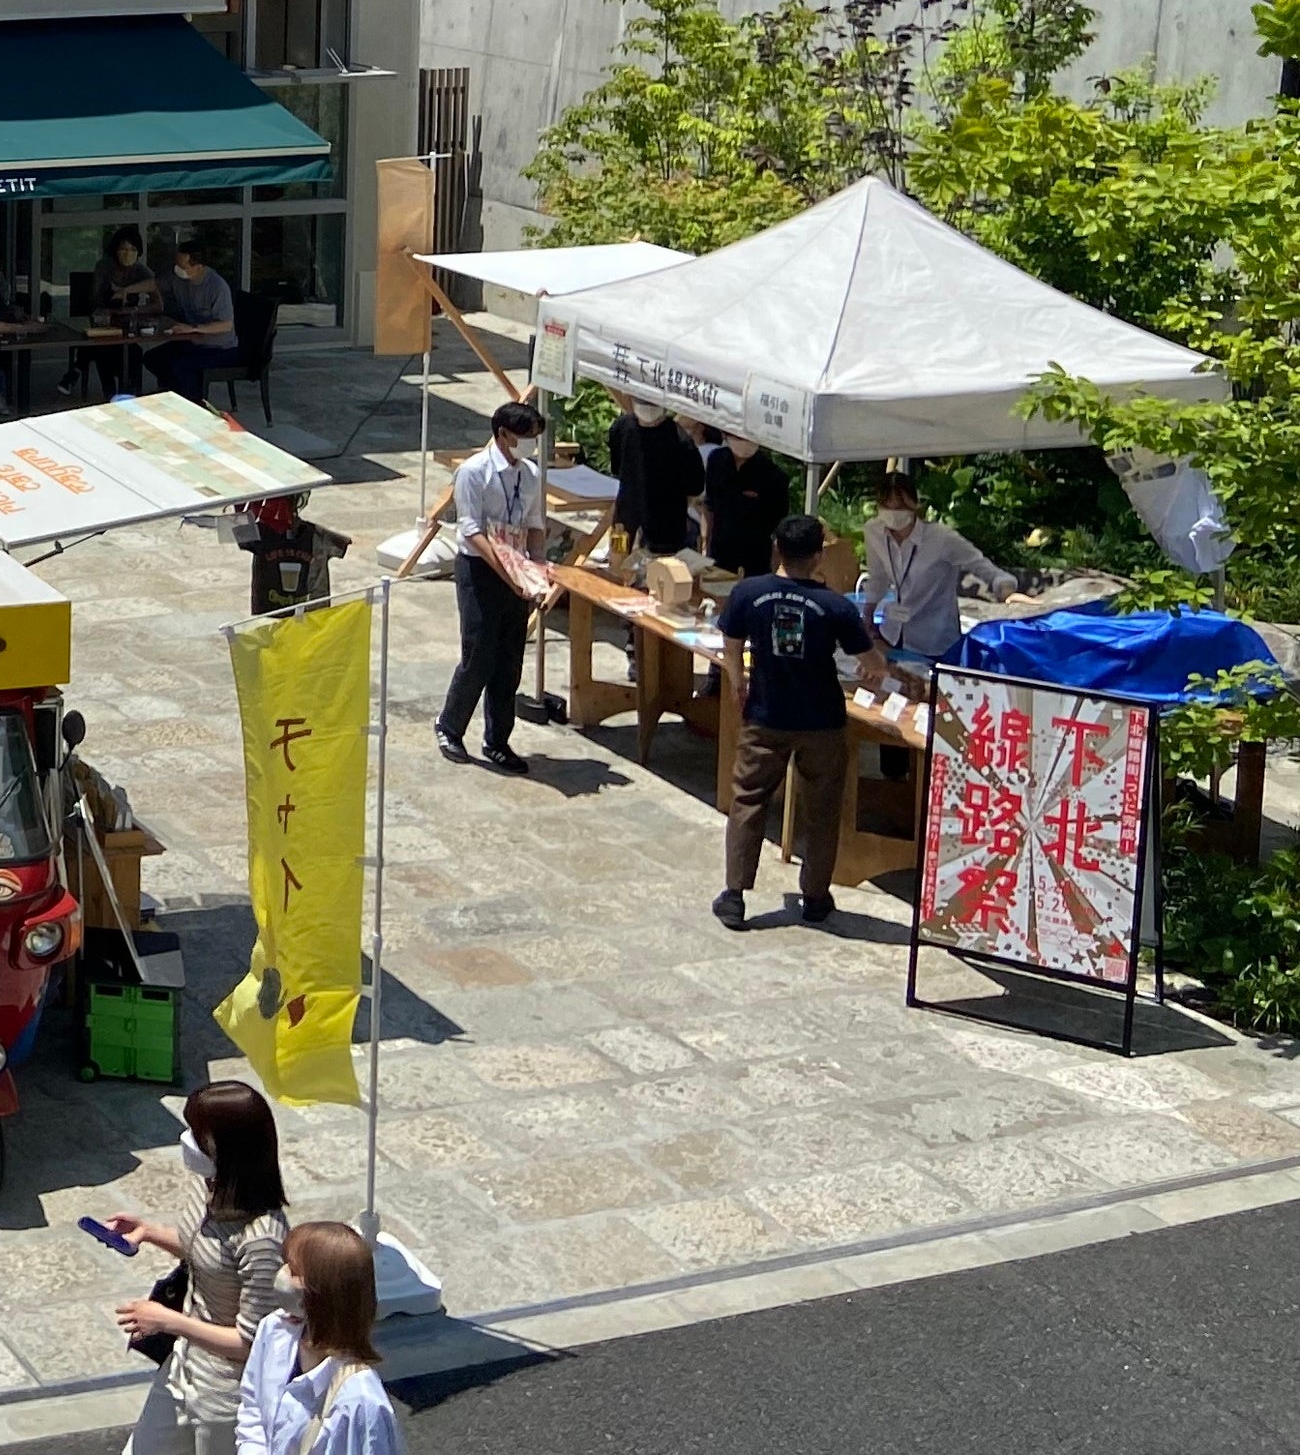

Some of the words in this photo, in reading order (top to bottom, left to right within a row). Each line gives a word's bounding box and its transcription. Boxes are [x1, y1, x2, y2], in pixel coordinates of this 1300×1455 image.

[637, 357, 719, 409] 下北線路街
